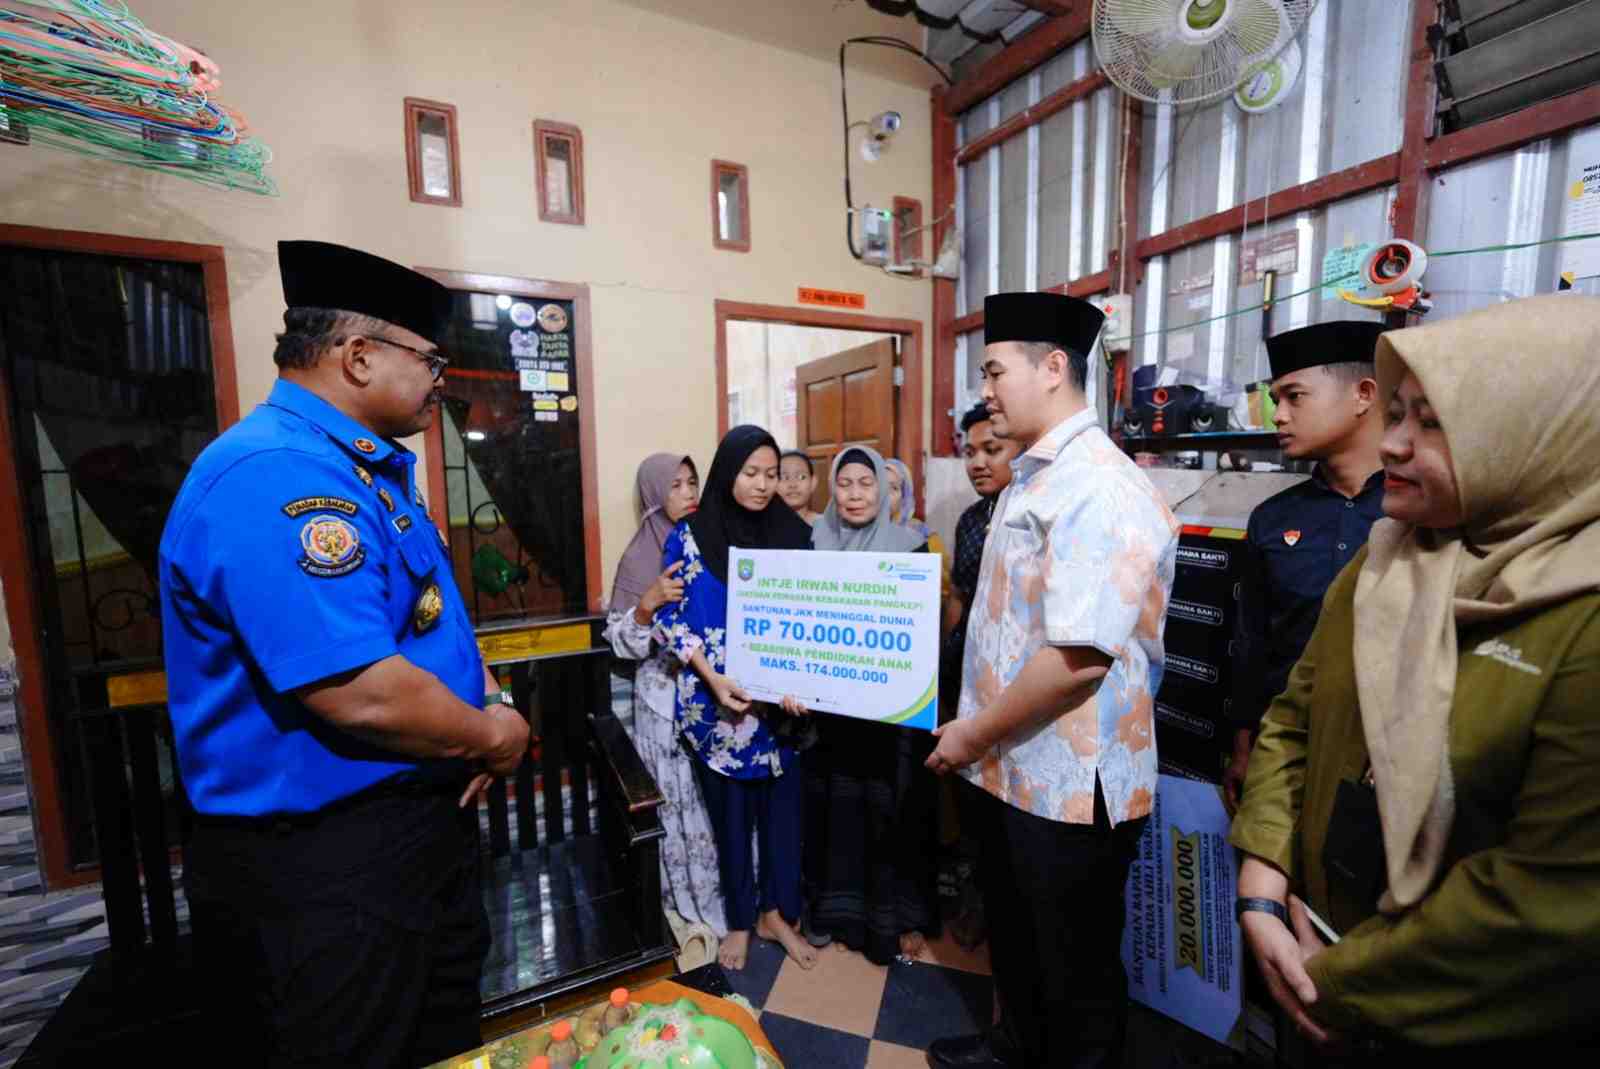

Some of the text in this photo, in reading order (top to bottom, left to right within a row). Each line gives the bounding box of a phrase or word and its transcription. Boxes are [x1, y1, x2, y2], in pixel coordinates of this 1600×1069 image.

[757, 577, 897, 596] INTJE IRWAN NURDIN
[743, 604, 914, 626] SANTUNAN JKK MENINGGAL DUNIA
[743, 617, 911, 652] RP 70.000.000
[760, 656, 889, 685] MAKS. 174.000.000
[804, 647, 874, 666] PENDIDIKAN
[878, 657, 913, 671] ANAK
[1132, 863, 1144, 911] BAPAK
[1143, 864, 1155, 901] AHLI
[1175, 838, 1198, 963] 20.000.000
[1144, 903, 1157, 960] KEPADA
